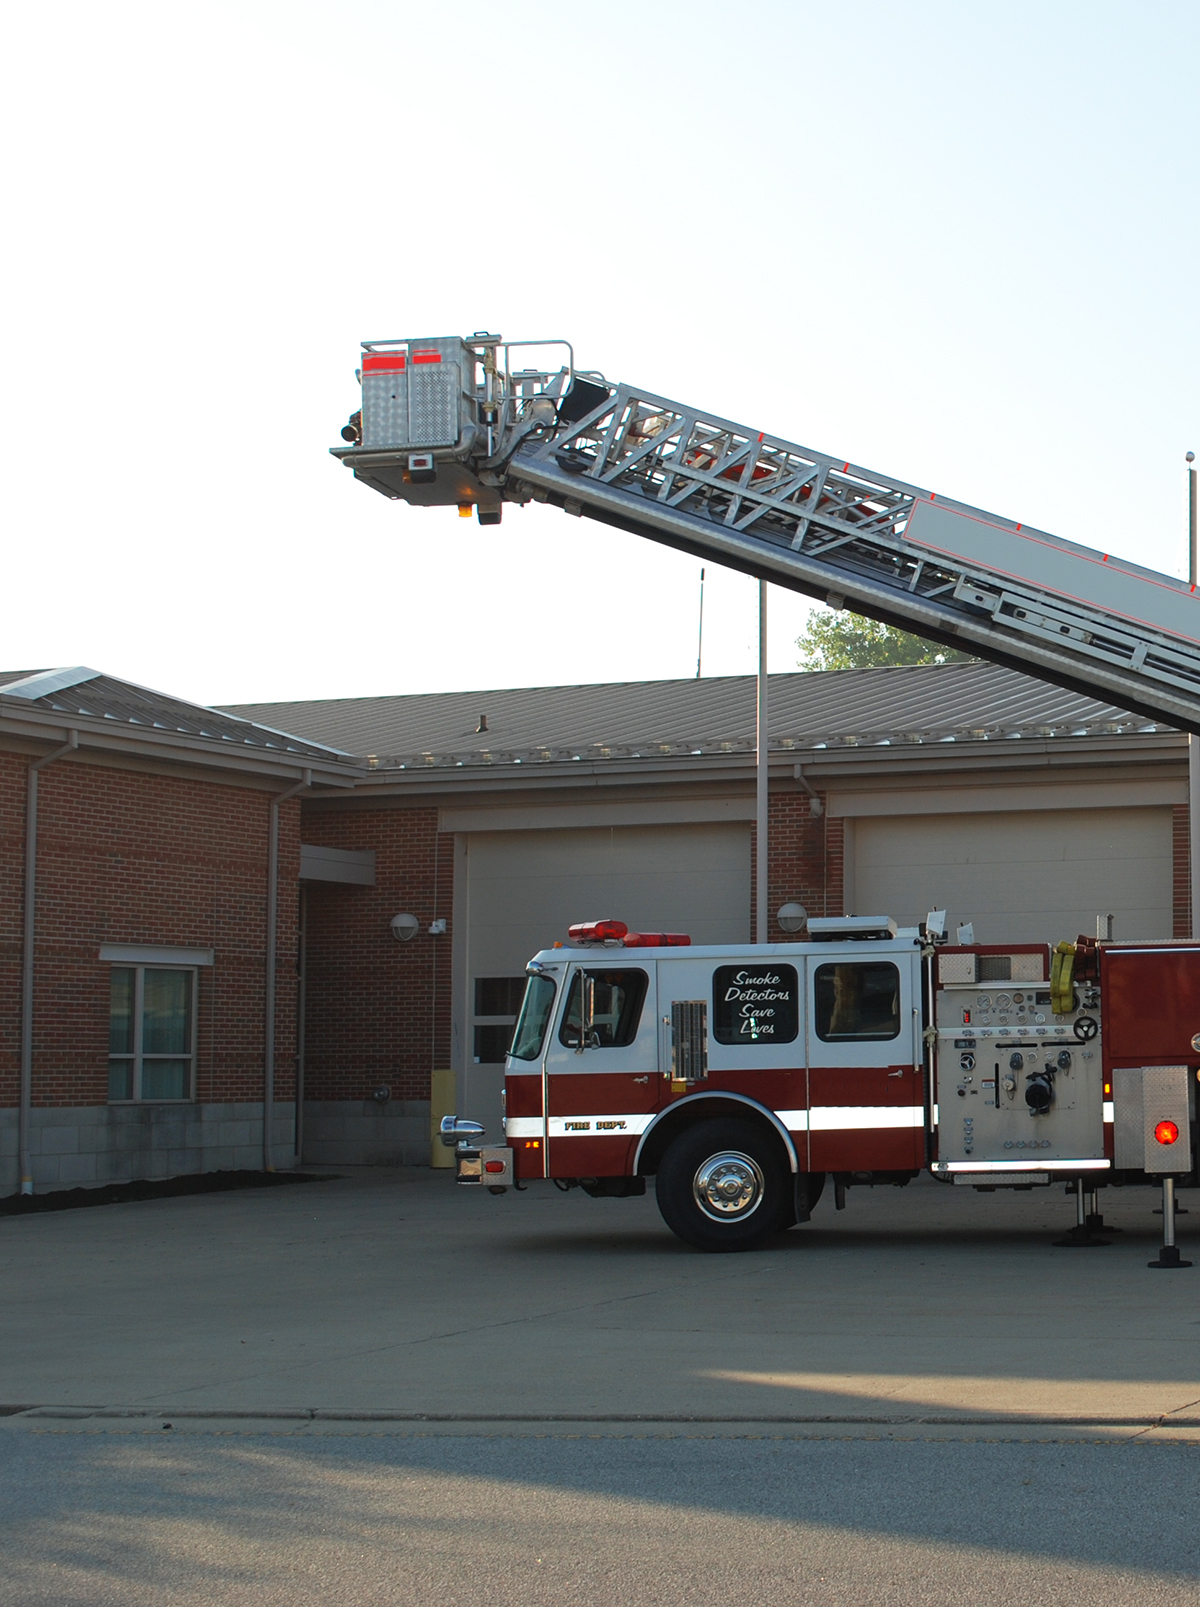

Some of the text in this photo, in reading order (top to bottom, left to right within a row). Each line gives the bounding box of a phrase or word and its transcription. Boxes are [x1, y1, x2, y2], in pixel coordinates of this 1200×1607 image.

[733, 970, 781, 985] Smoke
[724, 987, 789, 1001] Detectors
[738, 1003, 775, 1017] Save
[564, 1121, 591, 1131] FIRE
